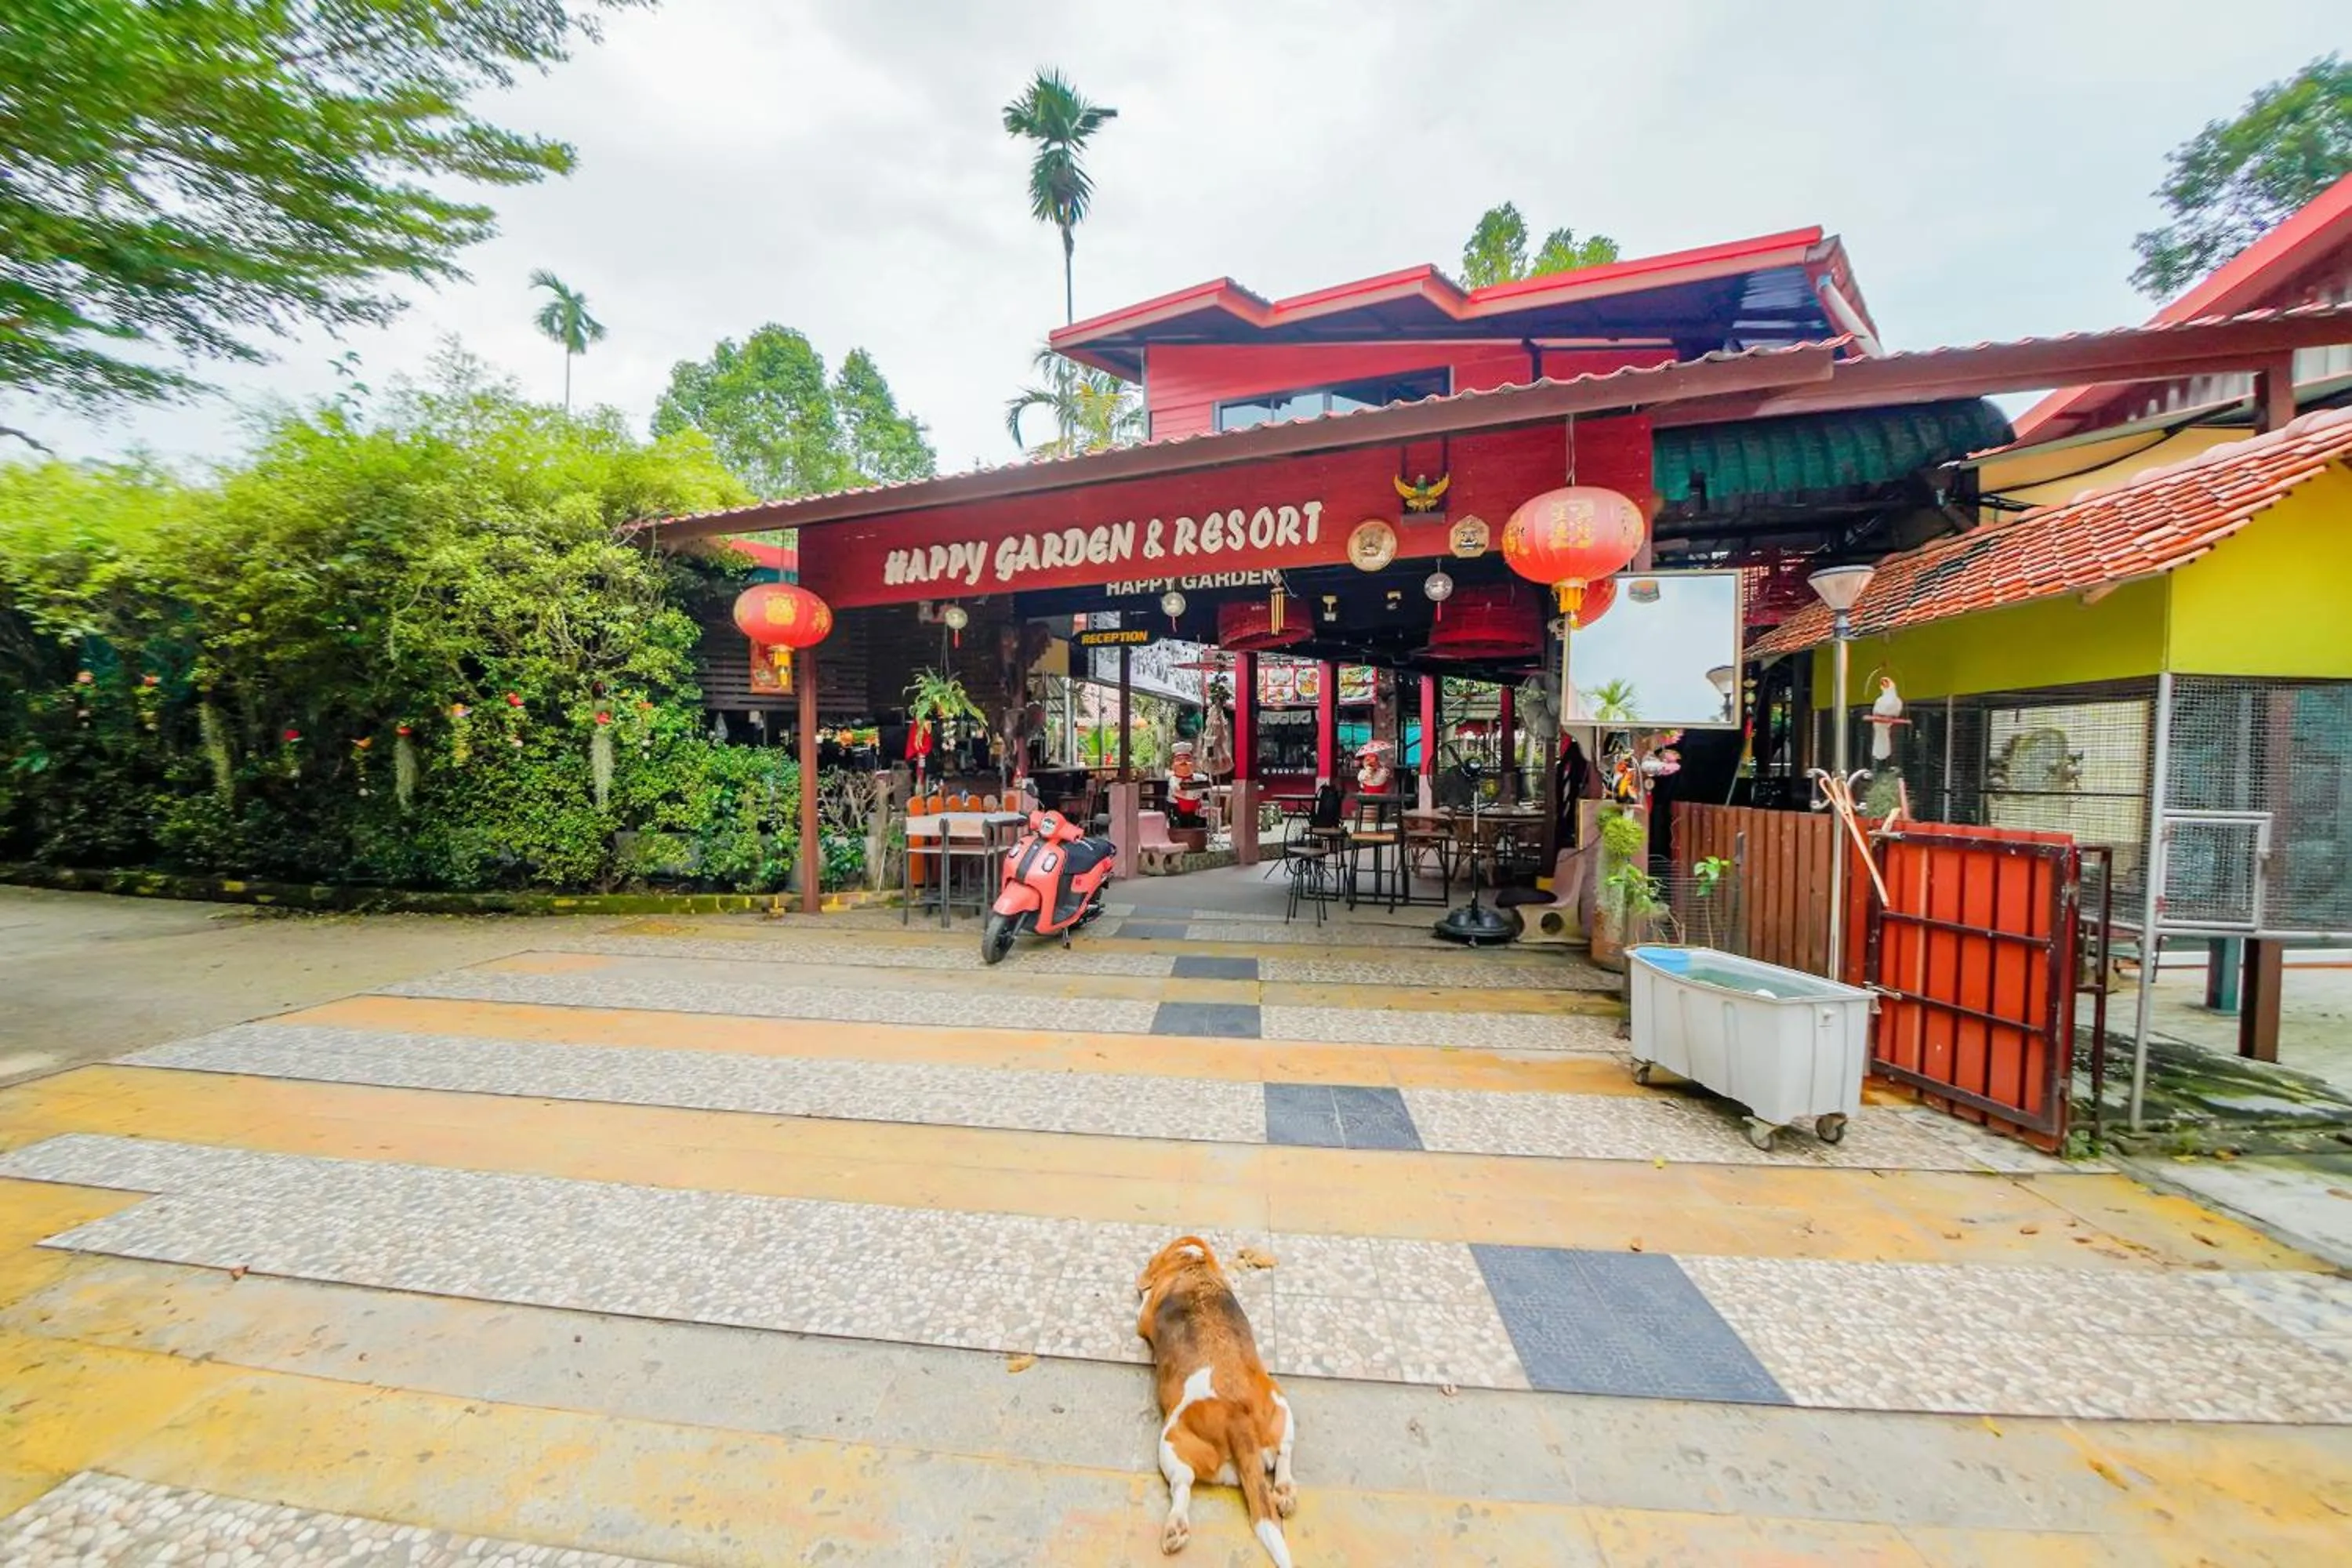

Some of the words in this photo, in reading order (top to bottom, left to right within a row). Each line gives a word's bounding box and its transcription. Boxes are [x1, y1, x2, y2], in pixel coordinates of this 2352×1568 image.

[883, 539, 988, 585] HAPPY
[994, 520, 1135, 579] GARDEN
[1142, 517, 1166, 559] &
[1173, 500, 1323, 556] RESORT
[1105, 577, 1174, 596] HAPPY
[1181, 568, 1281, 590] GARDEN
[1081, 630, 1148, 644] RECEPTION
